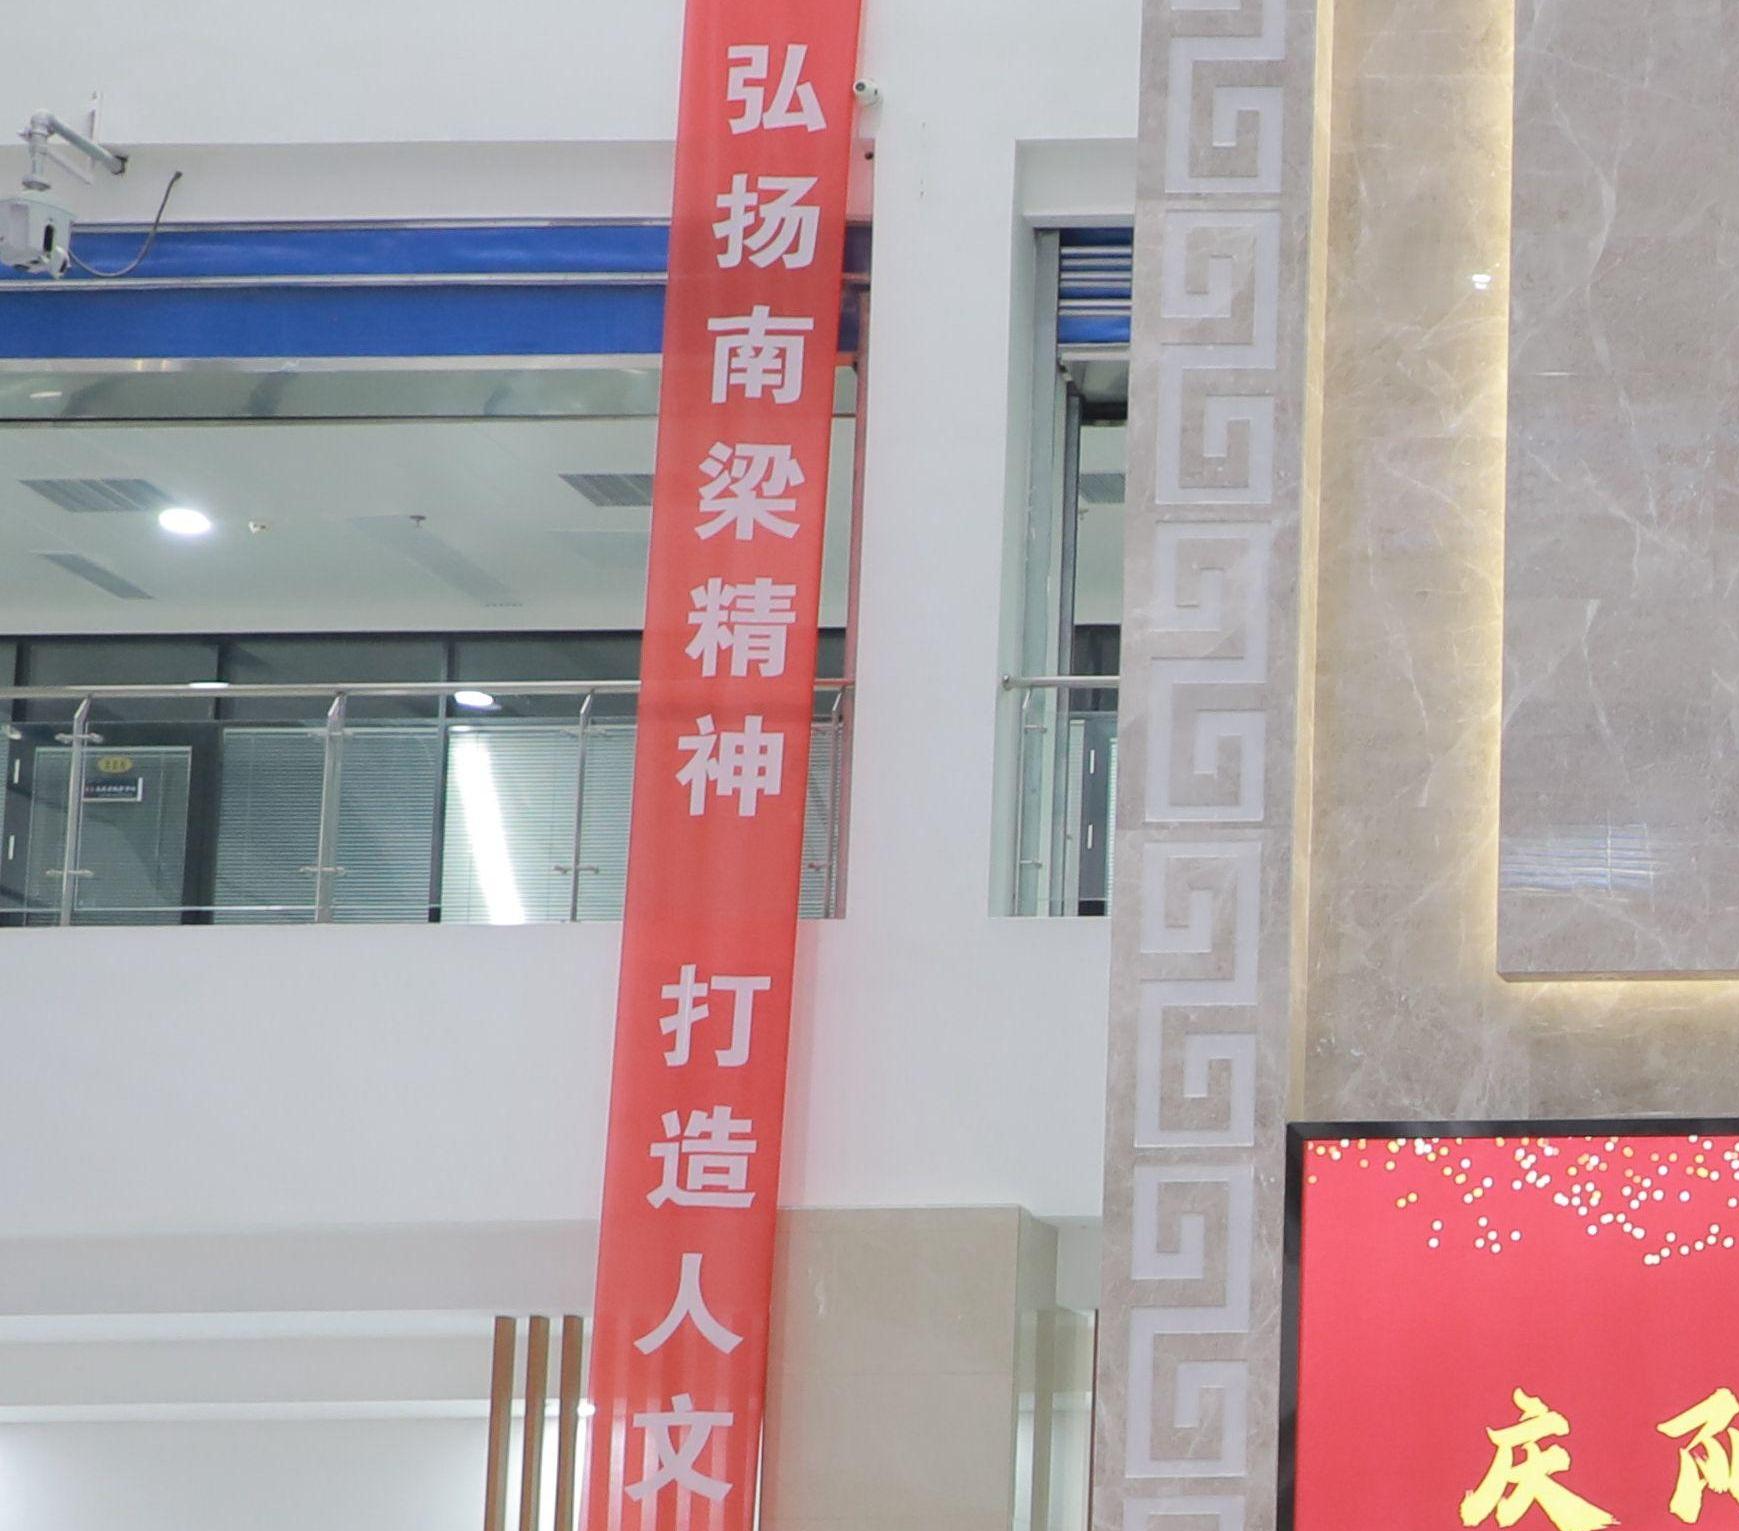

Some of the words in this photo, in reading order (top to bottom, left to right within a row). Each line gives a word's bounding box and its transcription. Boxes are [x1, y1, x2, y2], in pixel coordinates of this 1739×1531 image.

[676, 44, 826, 818] 弘扬南梁精神
